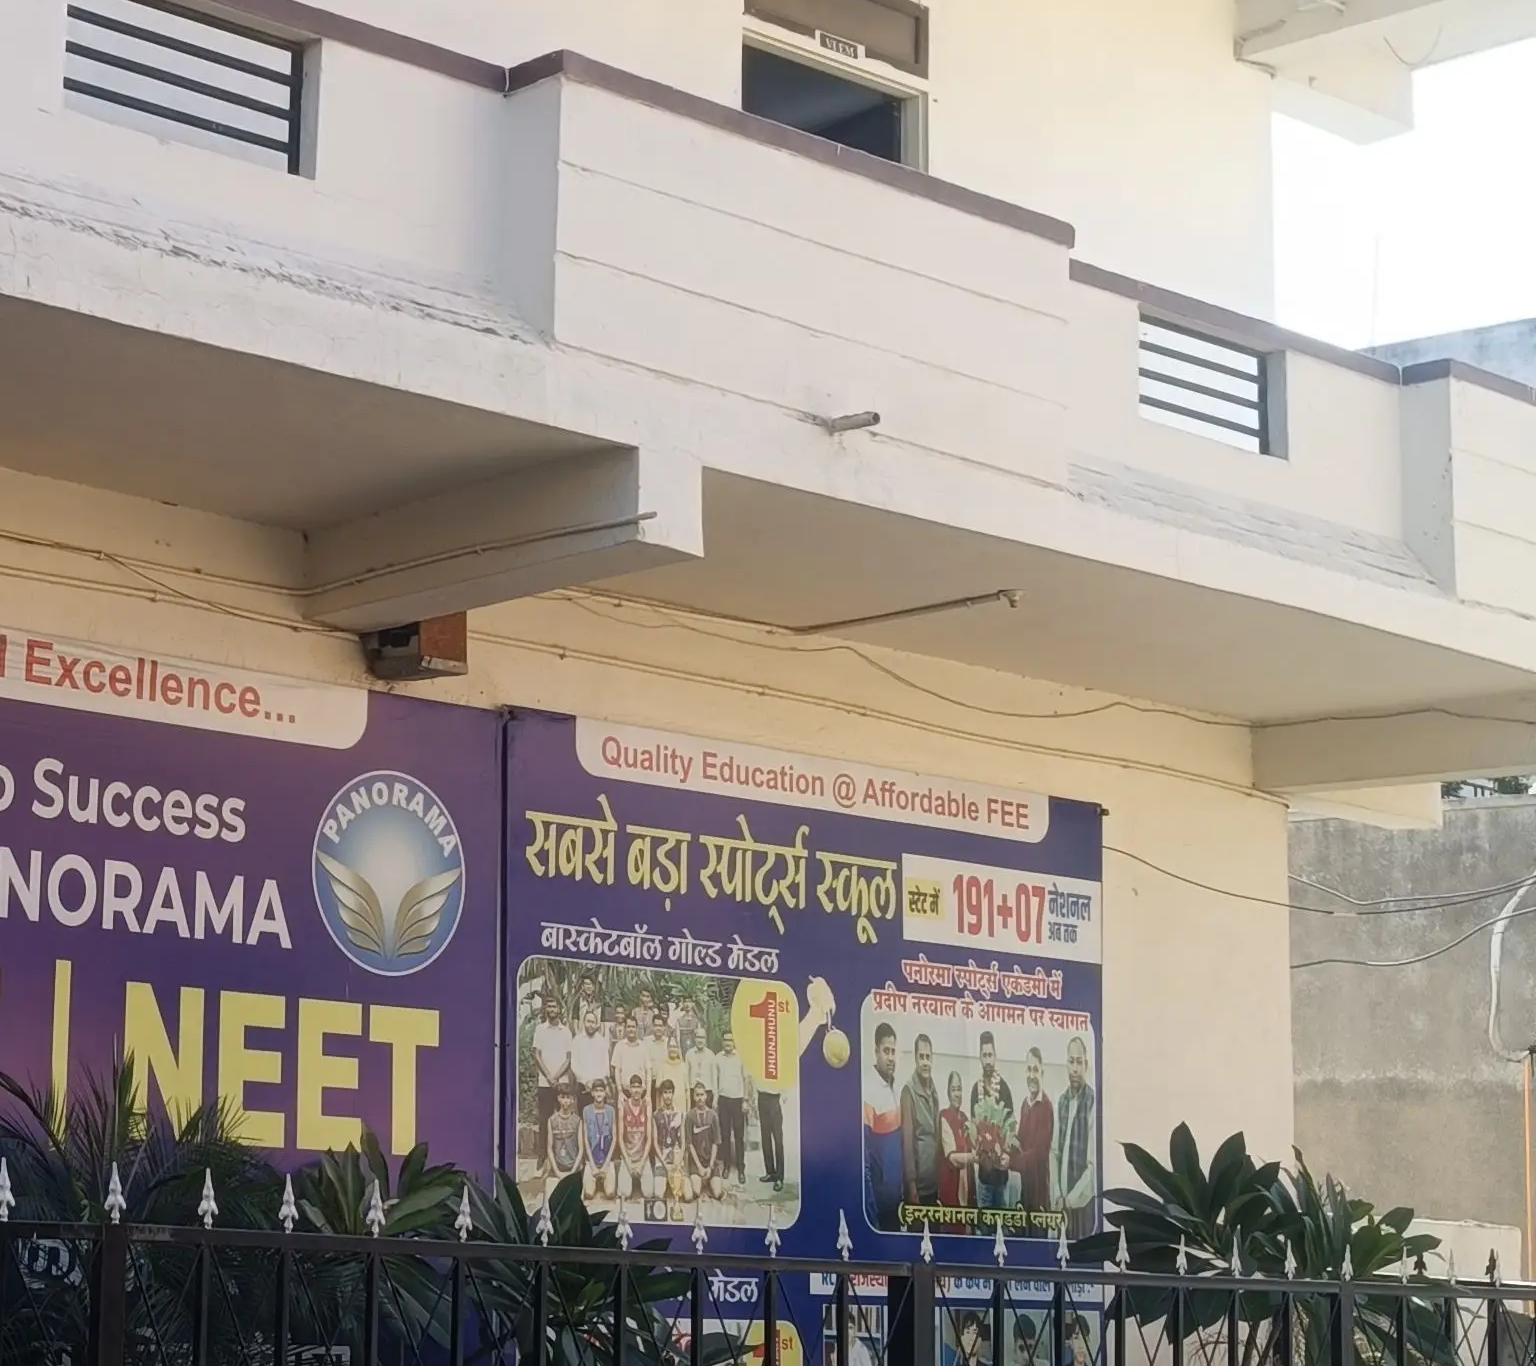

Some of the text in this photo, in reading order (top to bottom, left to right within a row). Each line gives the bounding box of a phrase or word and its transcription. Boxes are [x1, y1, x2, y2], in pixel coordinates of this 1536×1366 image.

[25, 638, 297, 724] Excellence...
[32, 757, 247, 843] Success
[322, 781, 457, 858] PANORAMA
[601, 736, 1030, 830] Quality Education @ Affordable FEE
[525, 794, 618, 886] सबसे
[626, 824, 691, 912] बड़ा
[815, 850, 898, 944] स्कूल
[953, 874, 1046, 944] 191+07
[1047, 882, 1092, 922] नेशनल
[540, 917, 780, 974] बास्केटबॉल गोल्ड मेडल
[1029, 1007, 1046, 1027] पर
[123, 981, 440, 1157] NEET
